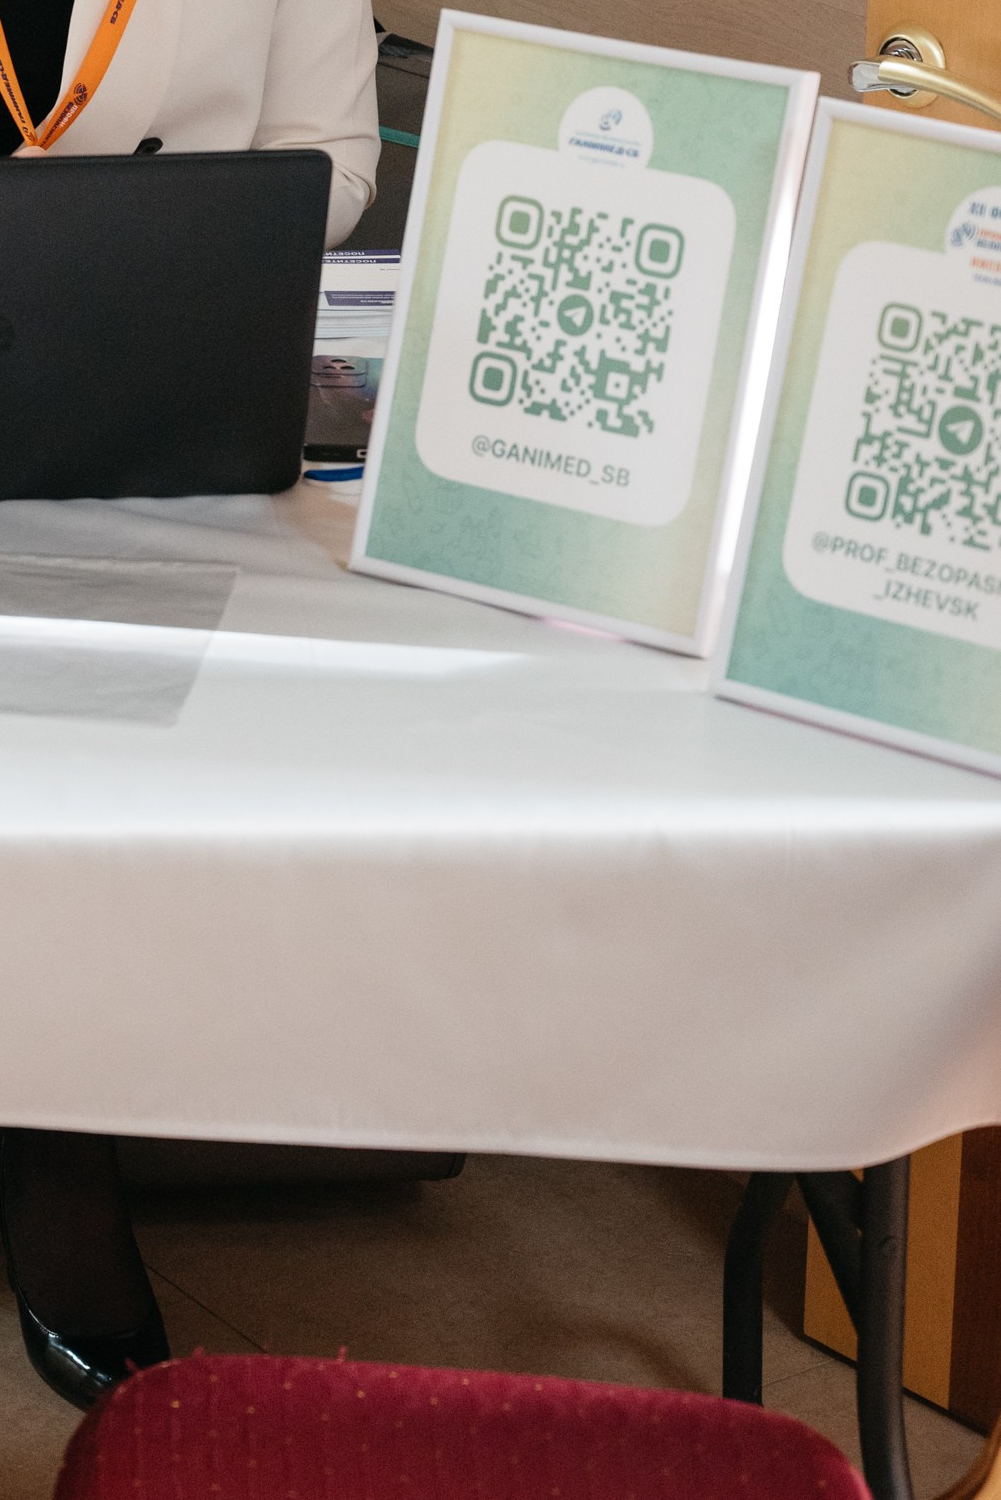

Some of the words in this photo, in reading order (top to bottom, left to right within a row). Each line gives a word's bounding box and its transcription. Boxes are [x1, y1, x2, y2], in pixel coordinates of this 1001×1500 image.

[471, 434, 631, 487] @GANIMED_SB
[811, 531, 1001, 597] @PROF_BEZOPAS
[872, 579, 980, 620] _IZHEVSK
